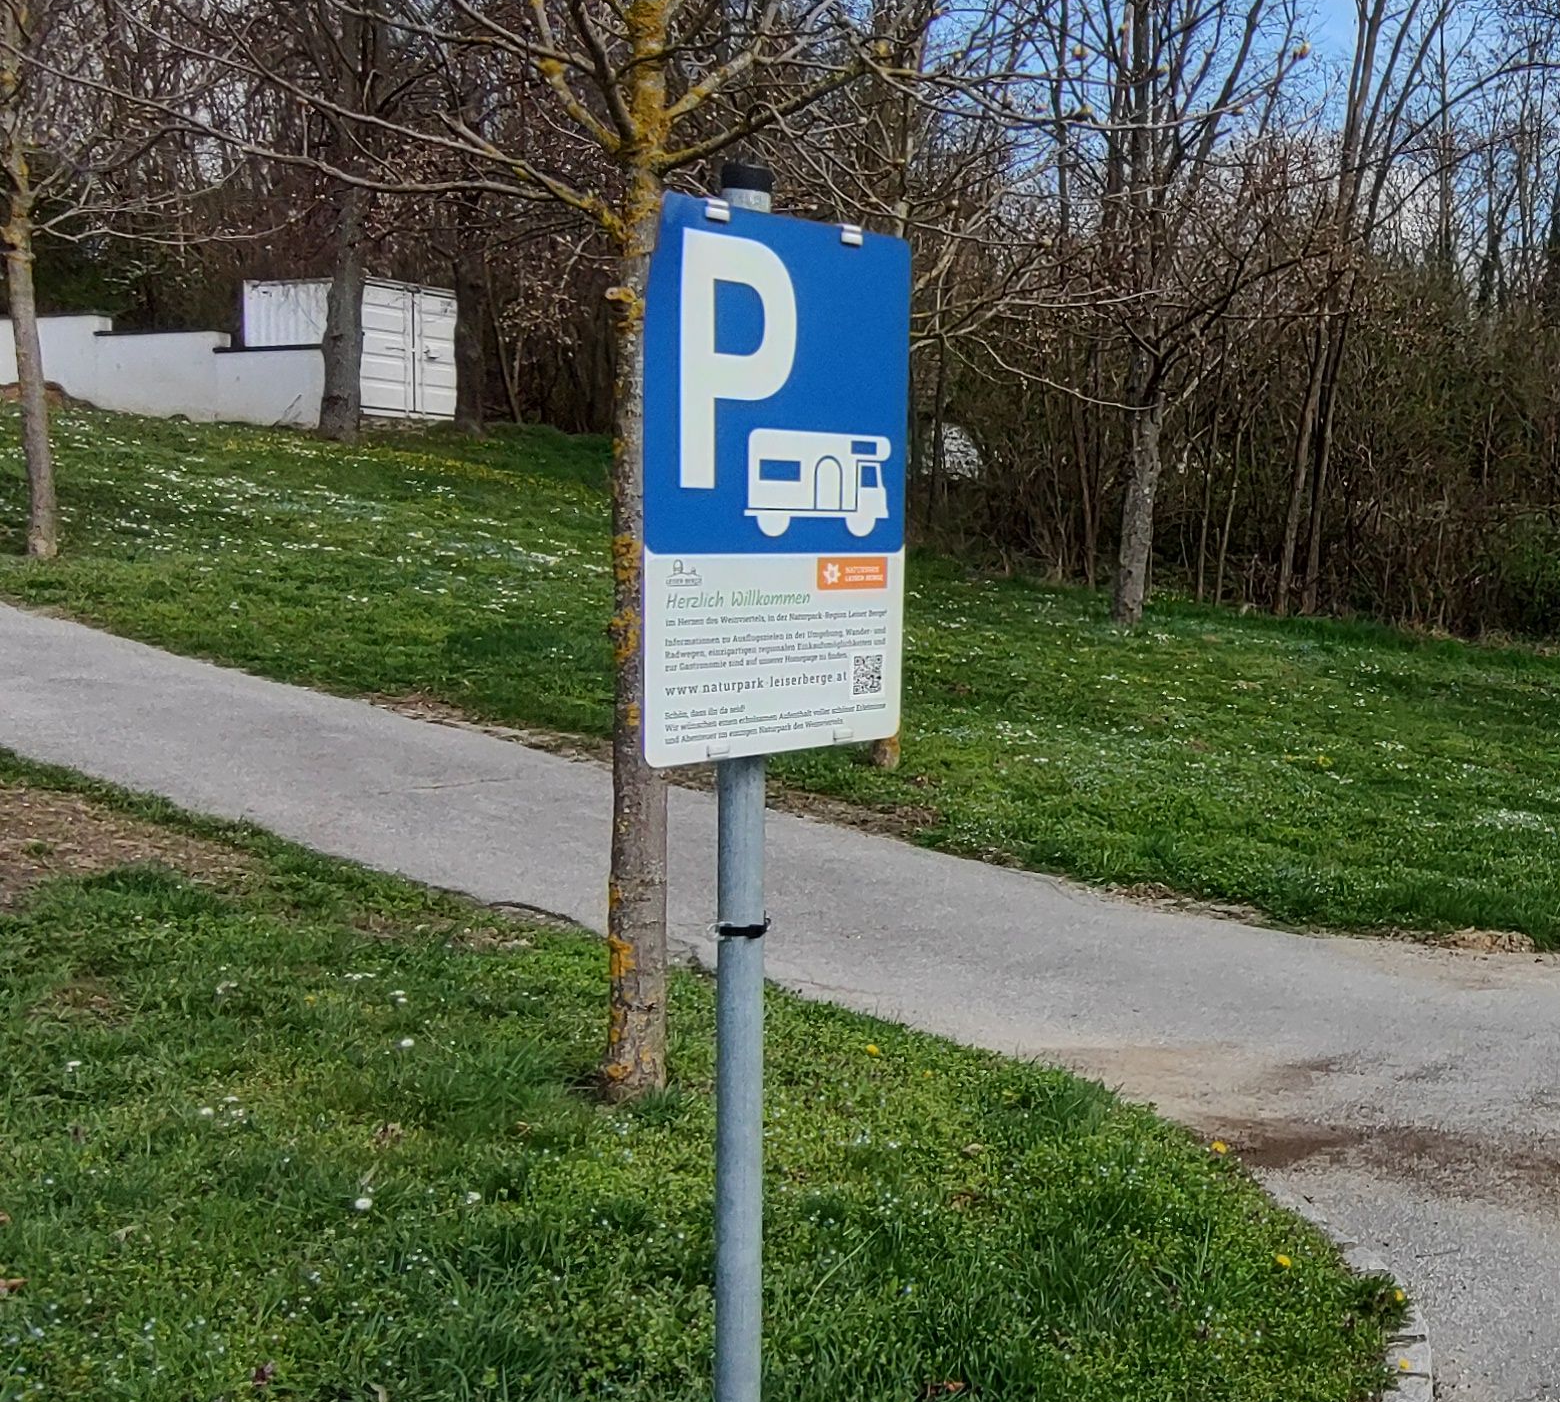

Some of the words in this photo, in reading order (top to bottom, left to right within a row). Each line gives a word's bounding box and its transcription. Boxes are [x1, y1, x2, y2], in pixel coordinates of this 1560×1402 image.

[680, 227, 797, 489] P
[666, 590, 724, 609] Herzlich
[731, 589, 811, 607] Willkommen
